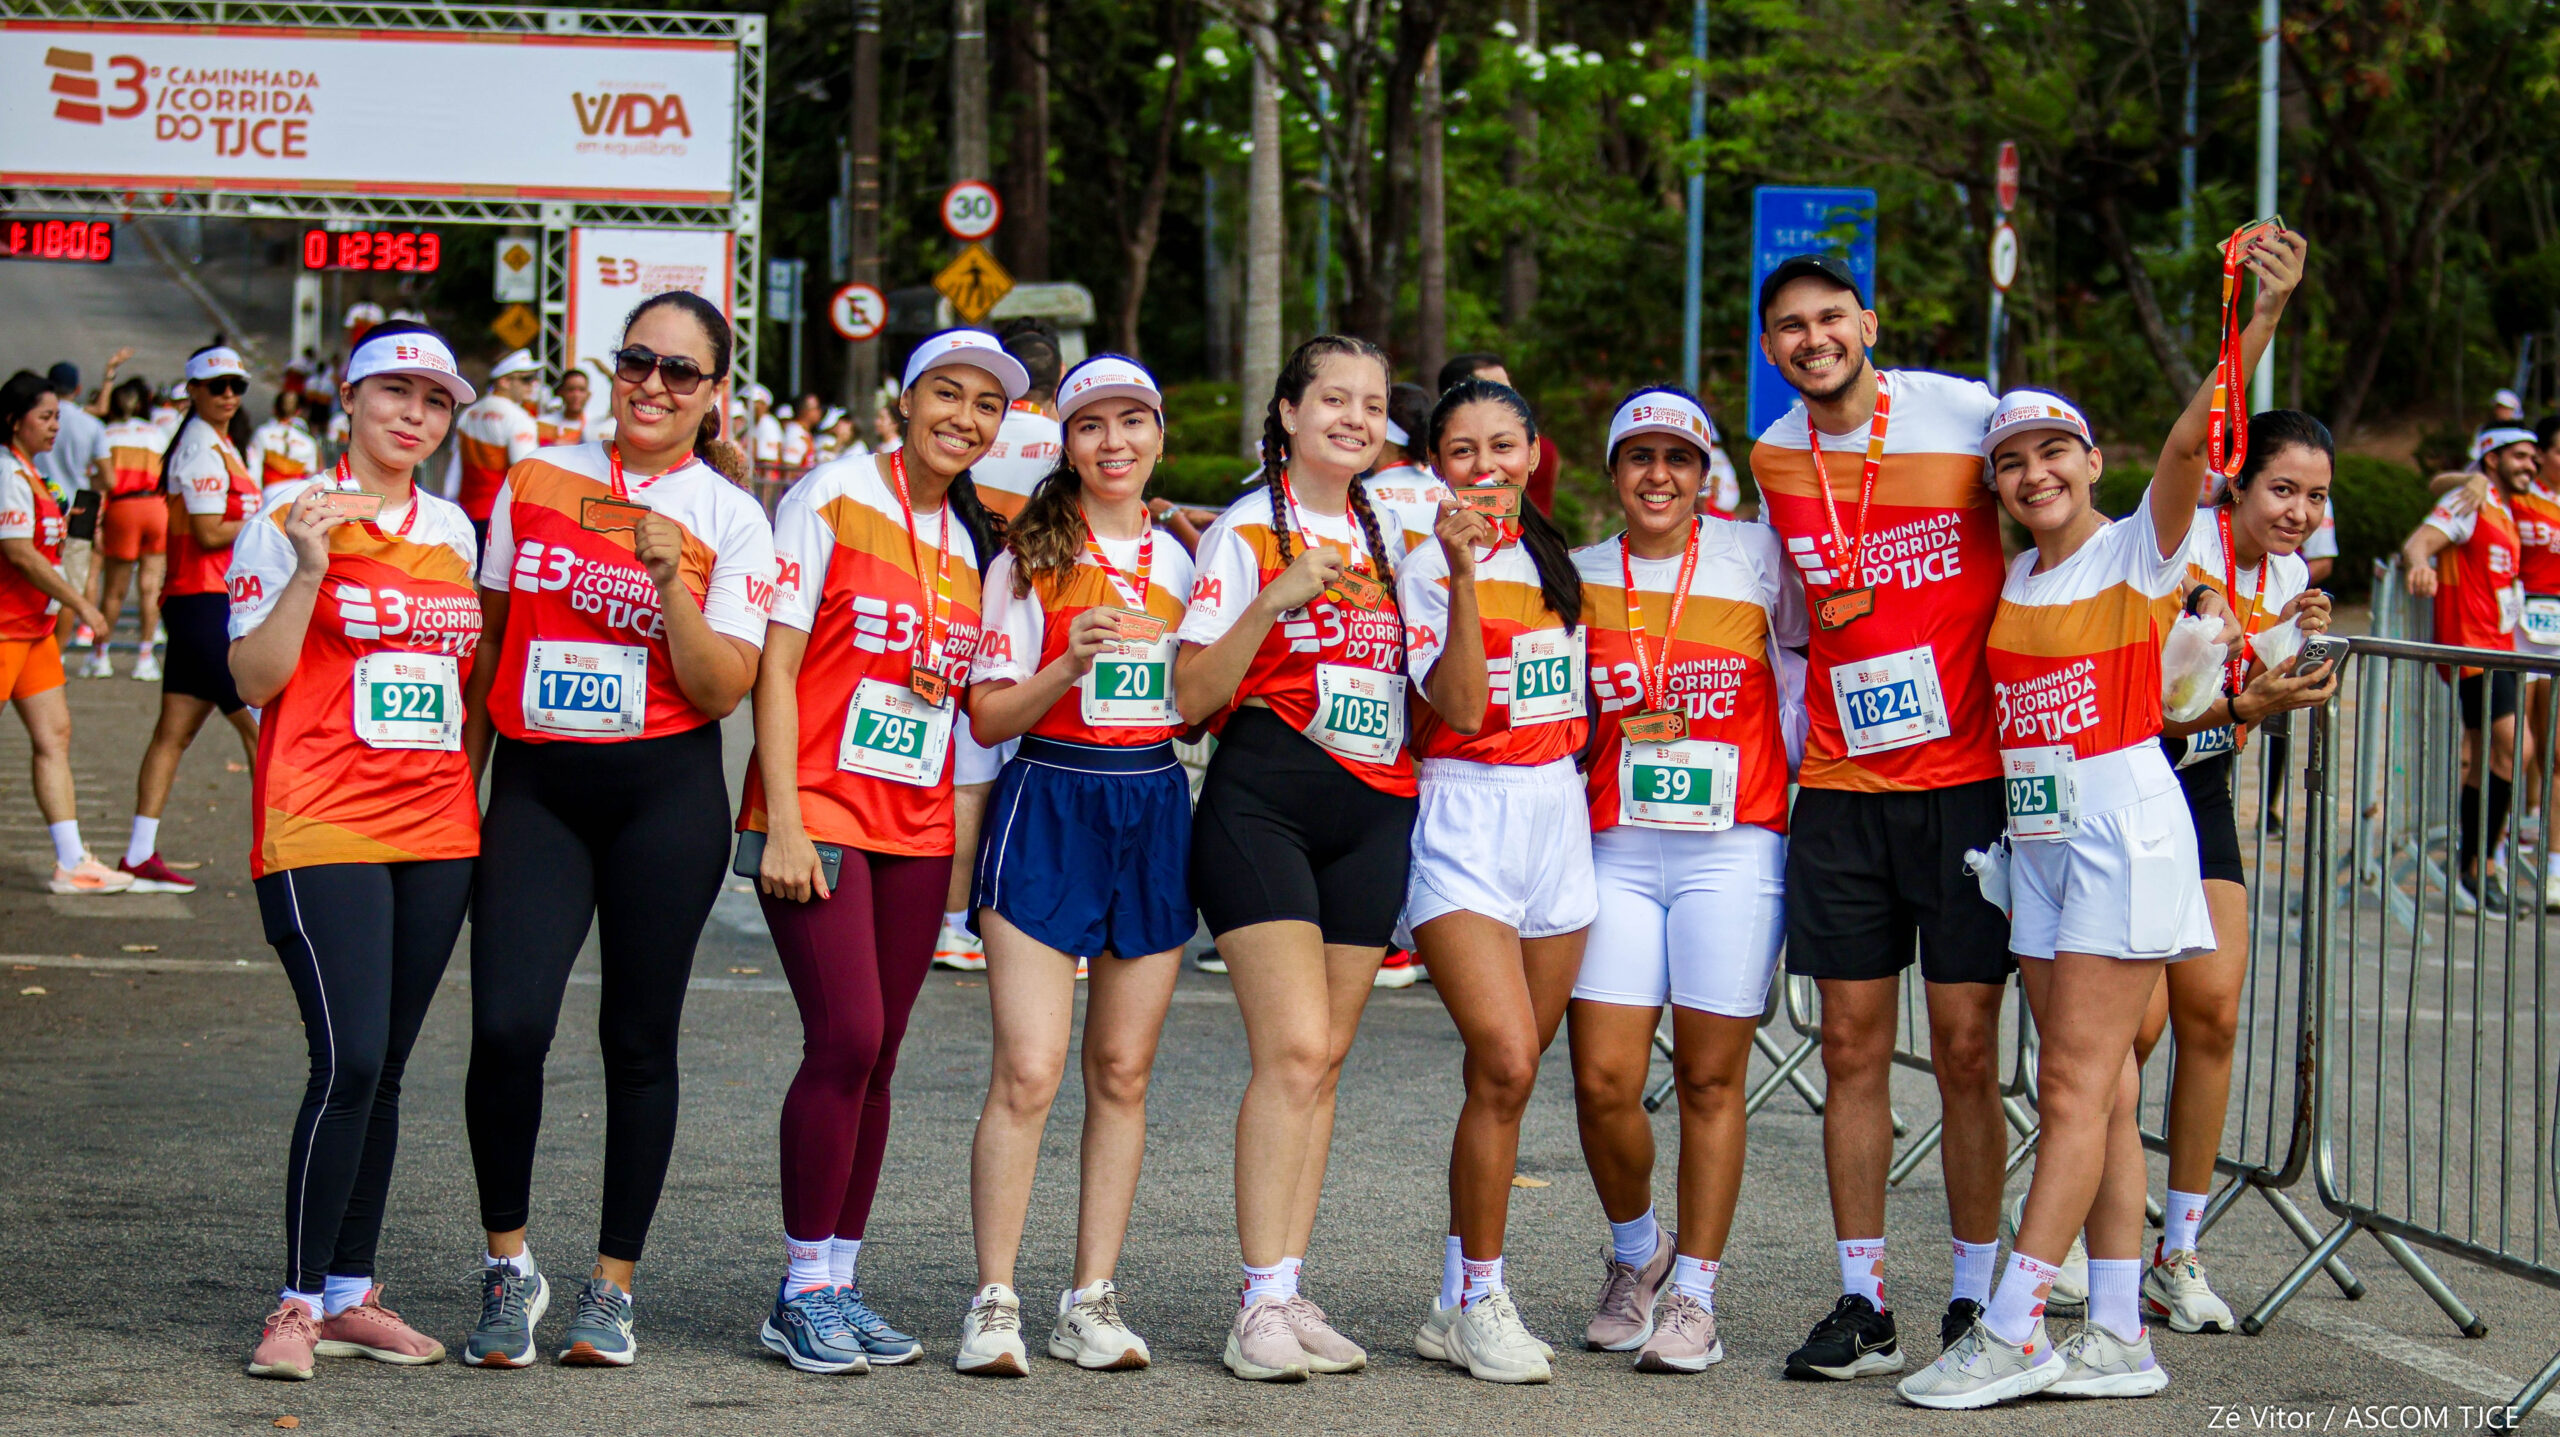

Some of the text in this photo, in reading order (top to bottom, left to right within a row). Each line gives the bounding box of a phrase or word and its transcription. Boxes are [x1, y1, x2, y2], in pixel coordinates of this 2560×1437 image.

[167, 66, 320, 90] CAMINHADA
[156, 86, 314, 114] /CORRIDA
[571, 91, 692, 139] VIDA
[156, 113, 308, 159] DO TJCE
[953, 194, 992, 219] 30
[1653, 414, 1686, 427] DO TJCE
[1862, 511, 1962, 547] CAMINHADA
[1860, 527, 1962, 568] /CORRIDA
[586, 561, 654, 586] CAMINH
[775, 557, 801, 592] DA
[1862, 564, 1893, 588] DO
[1894, 546, 1962, 590] TJCE
[413, 610, 483, 630] /CORRID
[572, 590, 666, 640] DO TJCE
[408, 630, 439, 646] DO
[1407, 624, 1439, 652] DA
[533, 654, 541, 674] 5KM
[1346, 640, 1404, 672] DO TJC
[360, 668, 368, 687] 3KM
[542, 673, 621, 710] 1790
[1114, 664, 1151, 698] 20
[1522, 657, 1565, 697] 916
[2012, 658, 2096, 698] CAMINHADA
[382, 685, 436, 719] 922
[1682, 690, 1738, 721] TJCE
[1850, 682, 1920, 726] 1824
[2012, 675, 2097, 718] /CORRIDA
[866, 712, 918, 754] 795
[1334, 696, 1388, 736] 1035
[2014, 695, 2100, 742] DO TJCE
[1624, 750, 1632, 769] 3KM
[1652, 768, 1692, 801] 39
[2010, 778, 2048, 813] 925
[1473, 1270, 1493, 1278] TJCE
